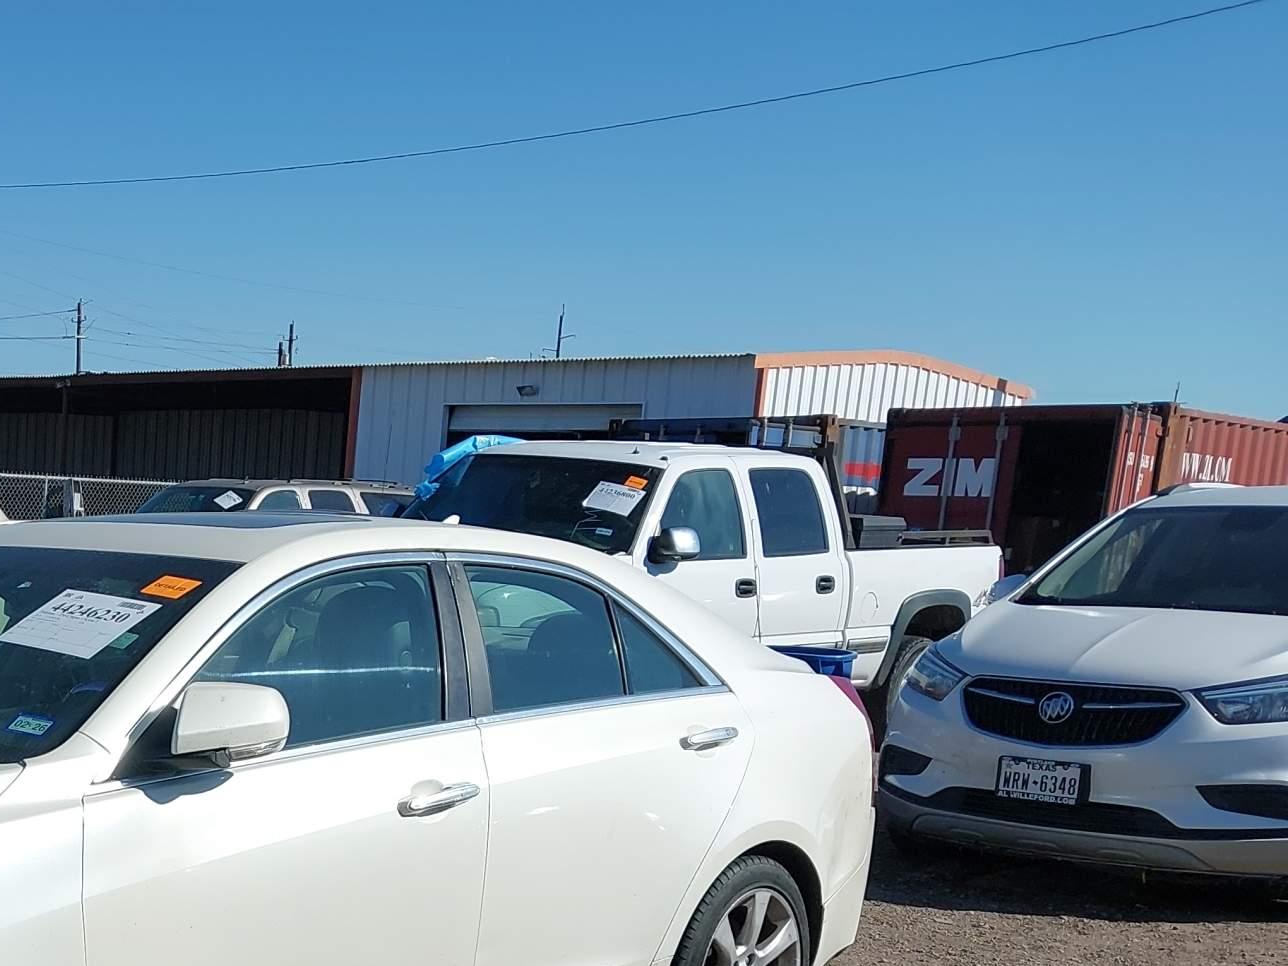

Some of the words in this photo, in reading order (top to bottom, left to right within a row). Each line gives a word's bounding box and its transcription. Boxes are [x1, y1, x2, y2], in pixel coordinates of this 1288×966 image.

[903, 457, 997, 497] ZIM
[51, 601, 131, 624] 44246230
[14, 719, 29, 729] 02
[32, 722, 48, 732] 26
[1026, 760, 1057, 772] TEXAS
